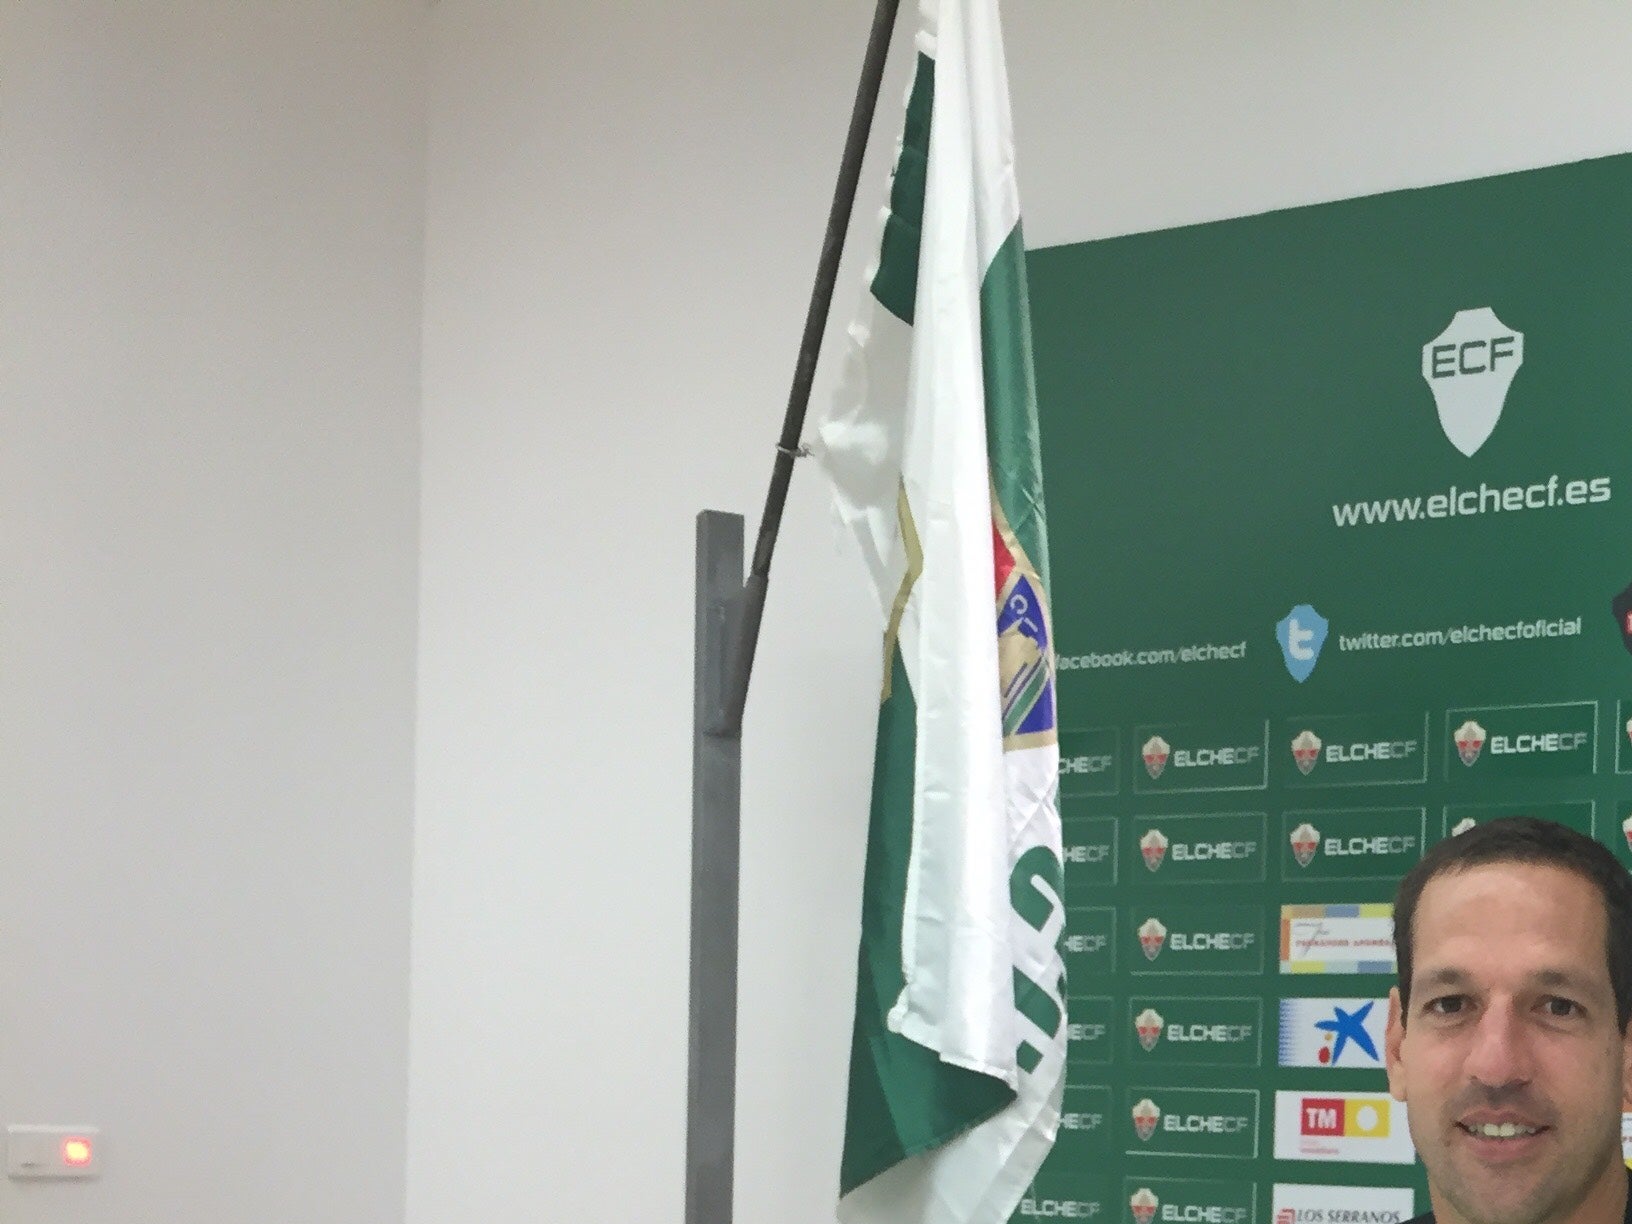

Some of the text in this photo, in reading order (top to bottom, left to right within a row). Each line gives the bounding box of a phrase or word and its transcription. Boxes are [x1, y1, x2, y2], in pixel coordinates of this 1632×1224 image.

[1429, 335, 1517, 379] ECF
[1332, 475, 1612, 527] www.elchecf.es
[1338, 616, 1582, 651] twitter.com/elchecfoficial
[1326, 740, 1418, 764] ELCHECF
[1490, 732, 1588, 755] ELCHECF
[1174, 746, 1260, 769] ELCHECF
[1172, 841, 1257, 861] ELCHECF
[1324, 836, 1417, 857] ELCHECF
[1170, 932, 1255, 951] ELCHECF
[1167, 1023, 1253, 1042] ELCHECF
[1163, 1114, 1248, 1133] ELCHECF
[1305, 1107, 1338, 1130] TM
[1162, 1204, 1247, 1224] ELCHECF
[1328, 1210, 1401, 1224] SERRANOS
